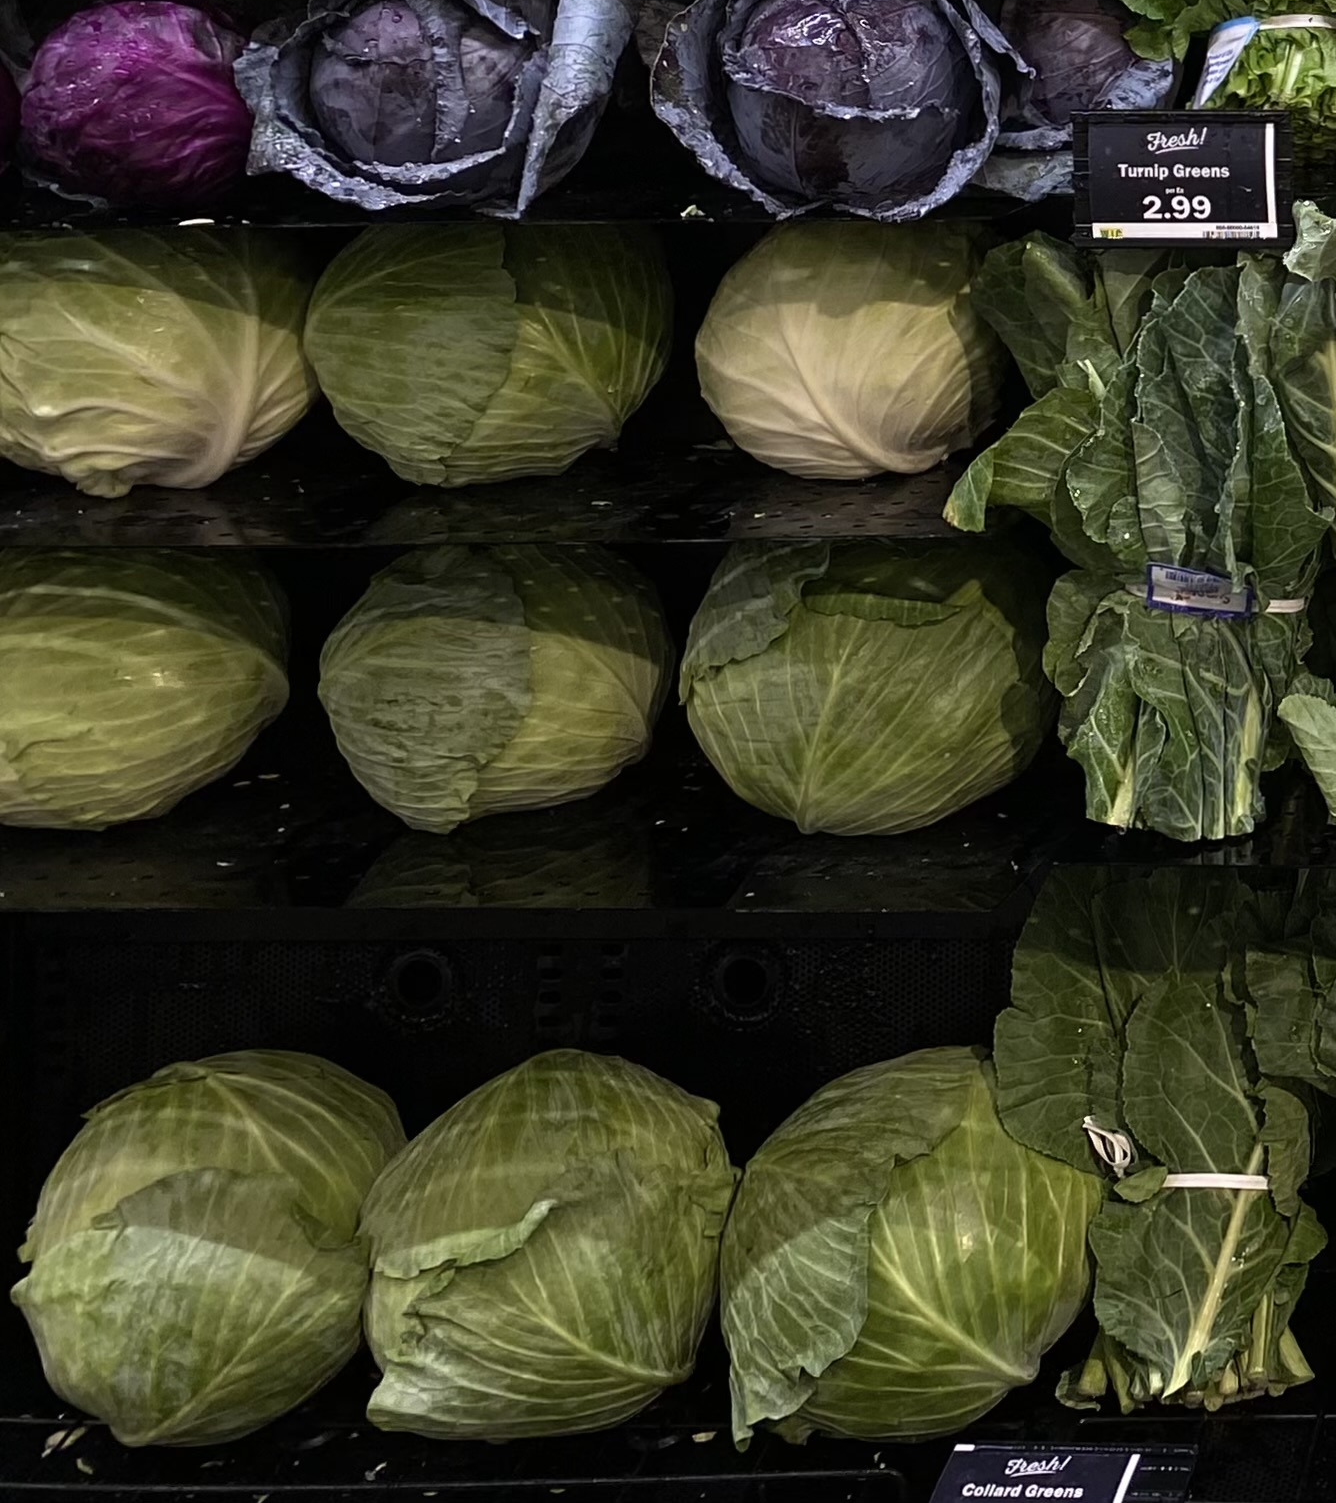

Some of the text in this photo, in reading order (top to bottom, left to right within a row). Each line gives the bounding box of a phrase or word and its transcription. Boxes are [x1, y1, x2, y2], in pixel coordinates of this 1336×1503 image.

[1146, 127, 1207, 151] Fresh!
[1117, 163, 1230, 180] Turnip Greens
[1142, 195, 1212, 220] 2.99
[1004, 1455, 1072, 1475] Fresh!
[962, 1483, 1084, 1499] Collard Greens
